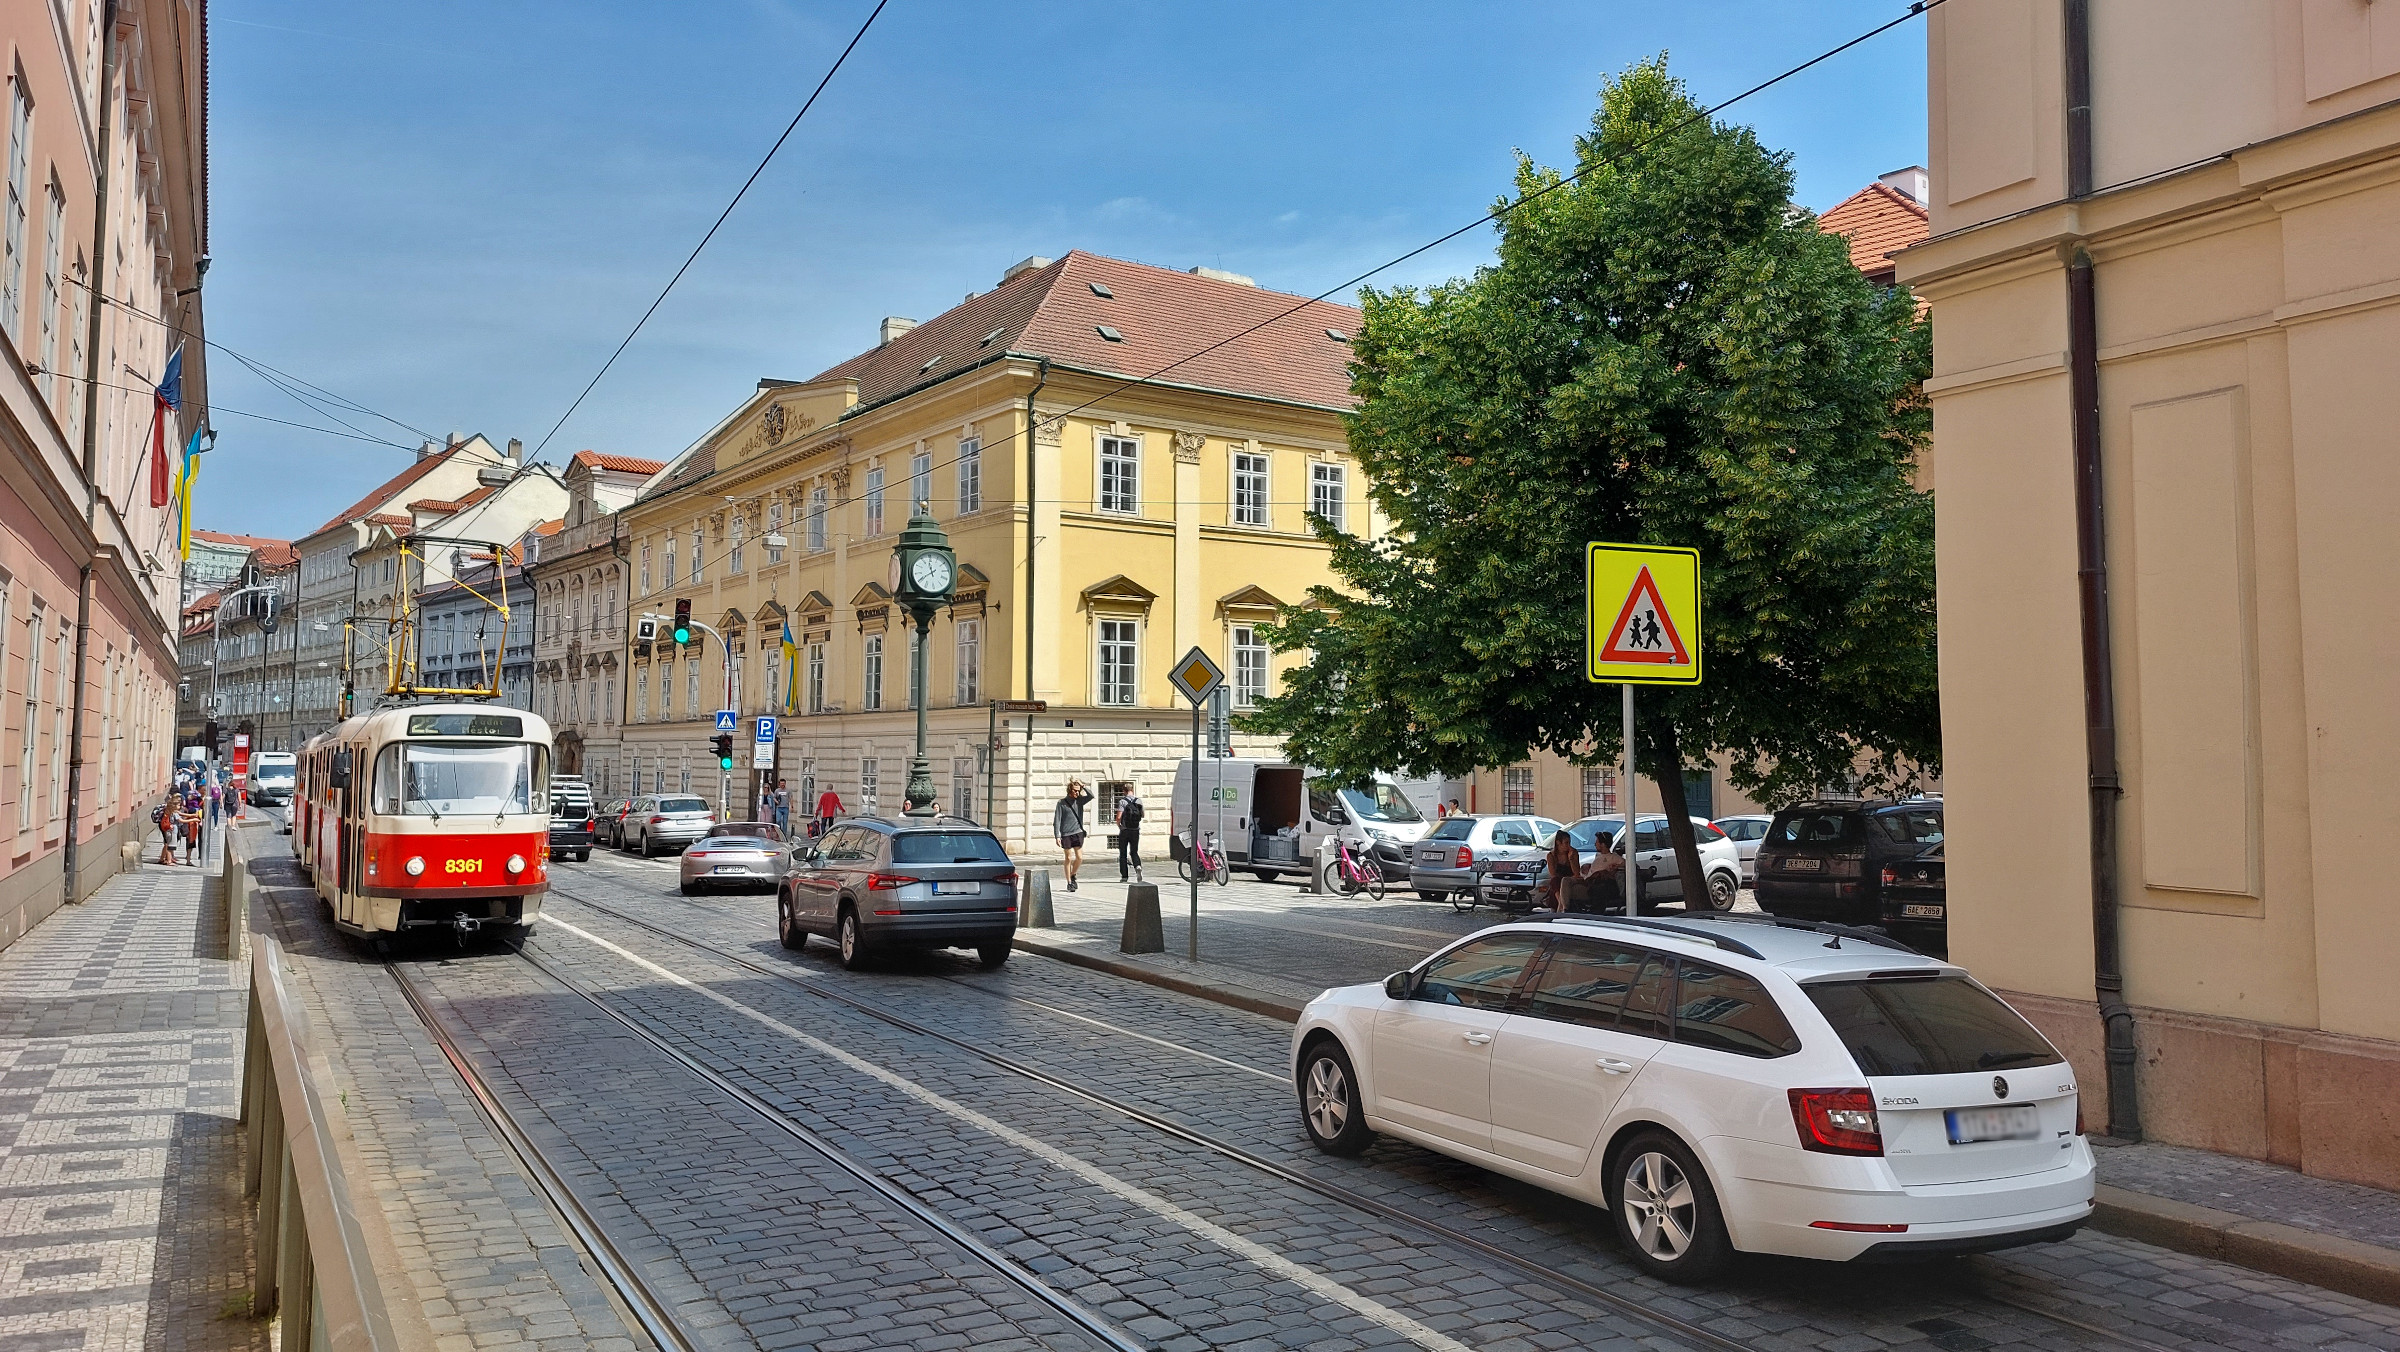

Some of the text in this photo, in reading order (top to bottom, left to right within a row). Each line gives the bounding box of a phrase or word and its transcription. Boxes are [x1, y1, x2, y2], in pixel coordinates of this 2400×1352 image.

[411, 716, 439, 734] 22
[760, 720, 772, 735] P
[444, 858, 483, 874] 8361
[1882, 1096, 1919, 1106] ŠKODA
